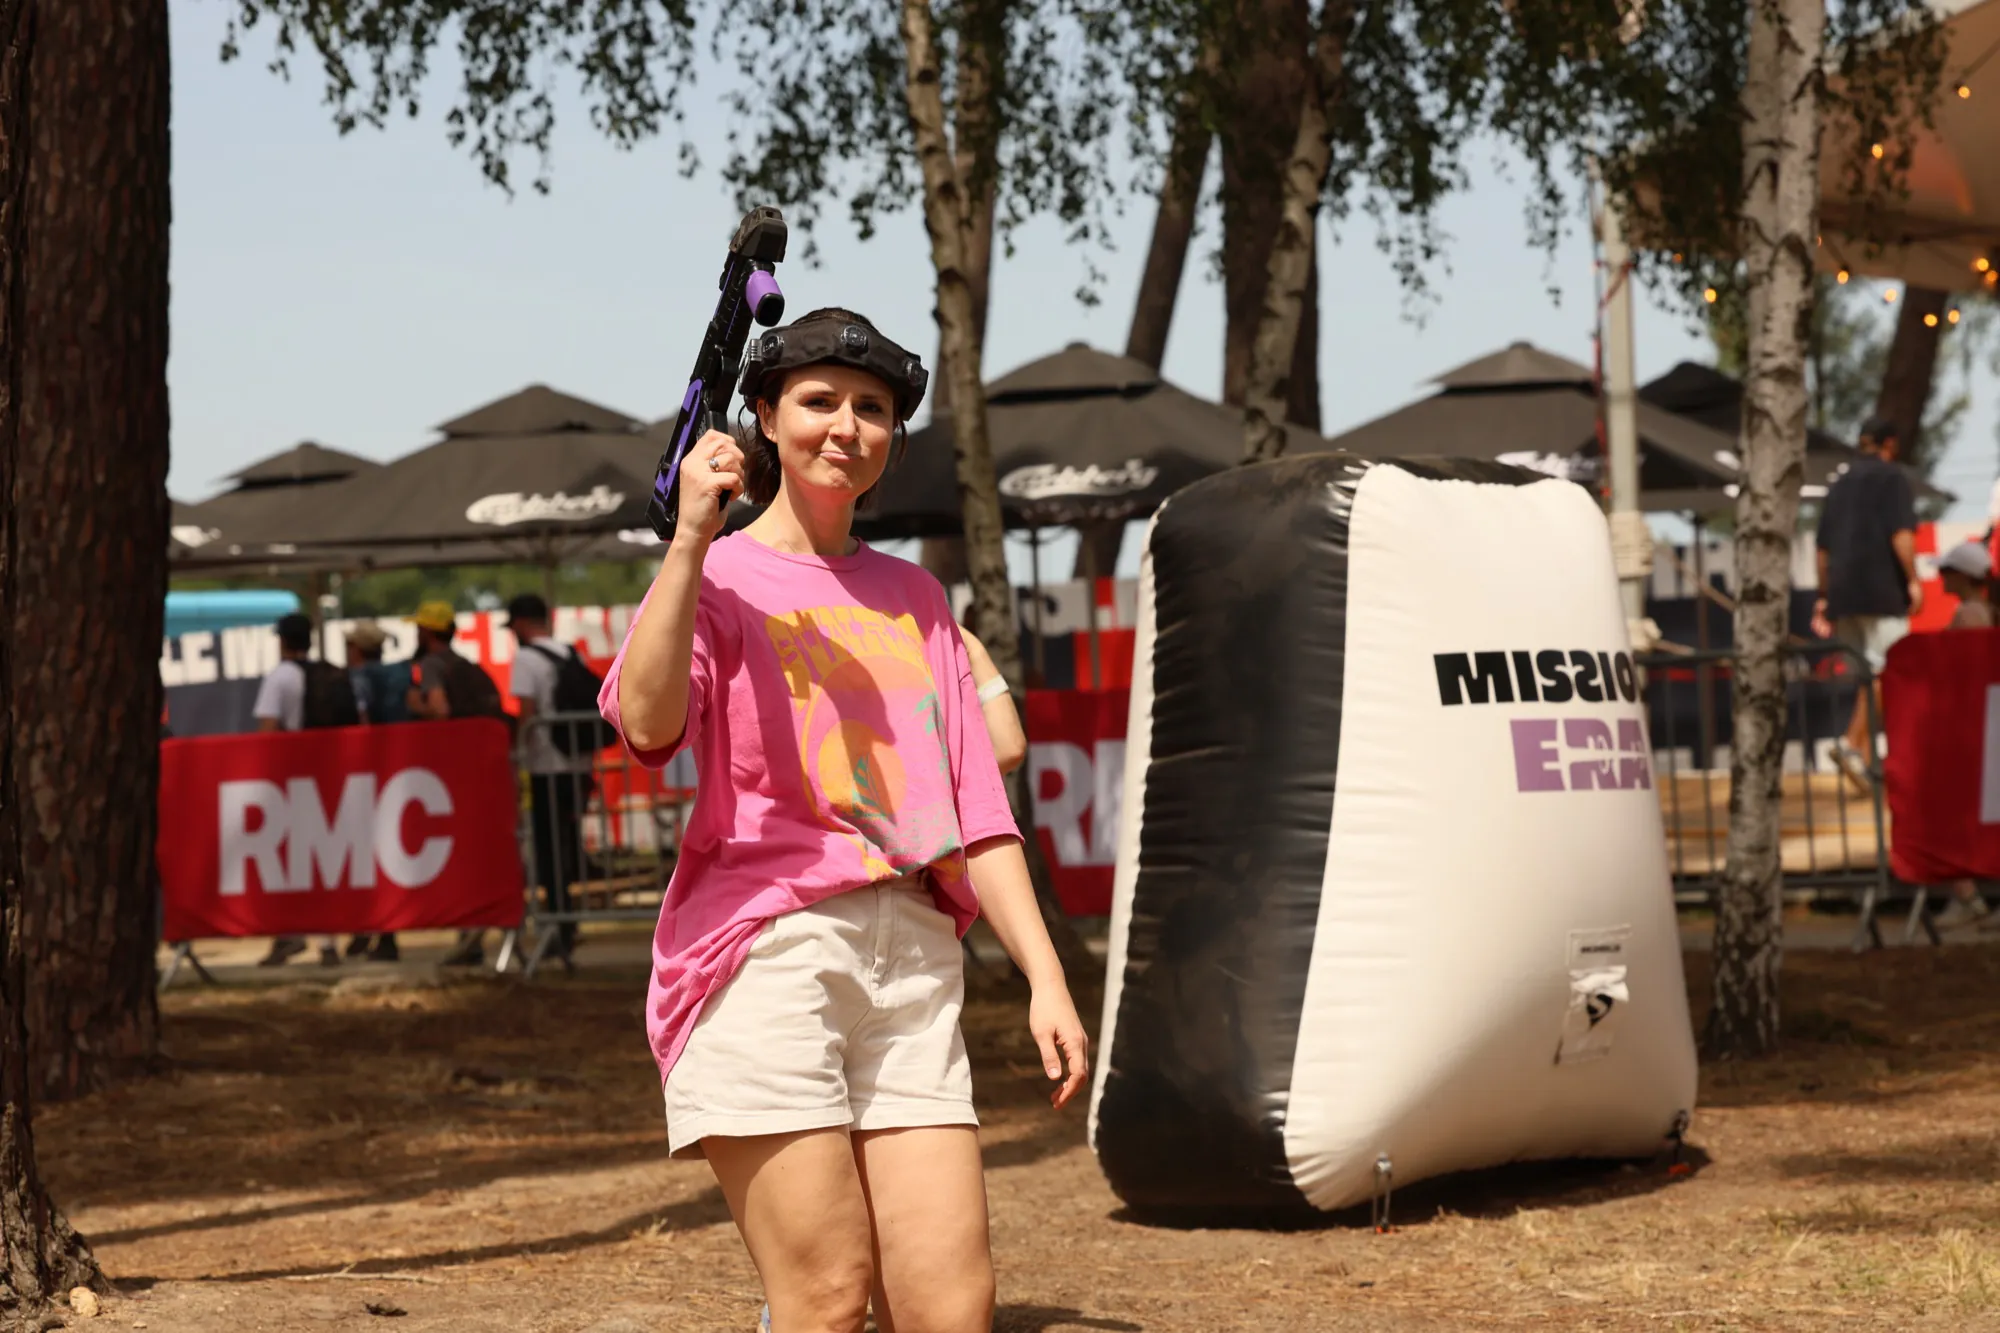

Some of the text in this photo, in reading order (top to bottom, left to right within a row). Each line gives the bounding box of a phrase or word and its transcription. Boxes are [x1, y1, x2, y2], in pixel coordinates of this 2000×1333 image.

[1433, 649, 1640, 706] MISSIO
[1509, 718, 1652, 793] ERA
[218, 767, 455, 896] RMC
